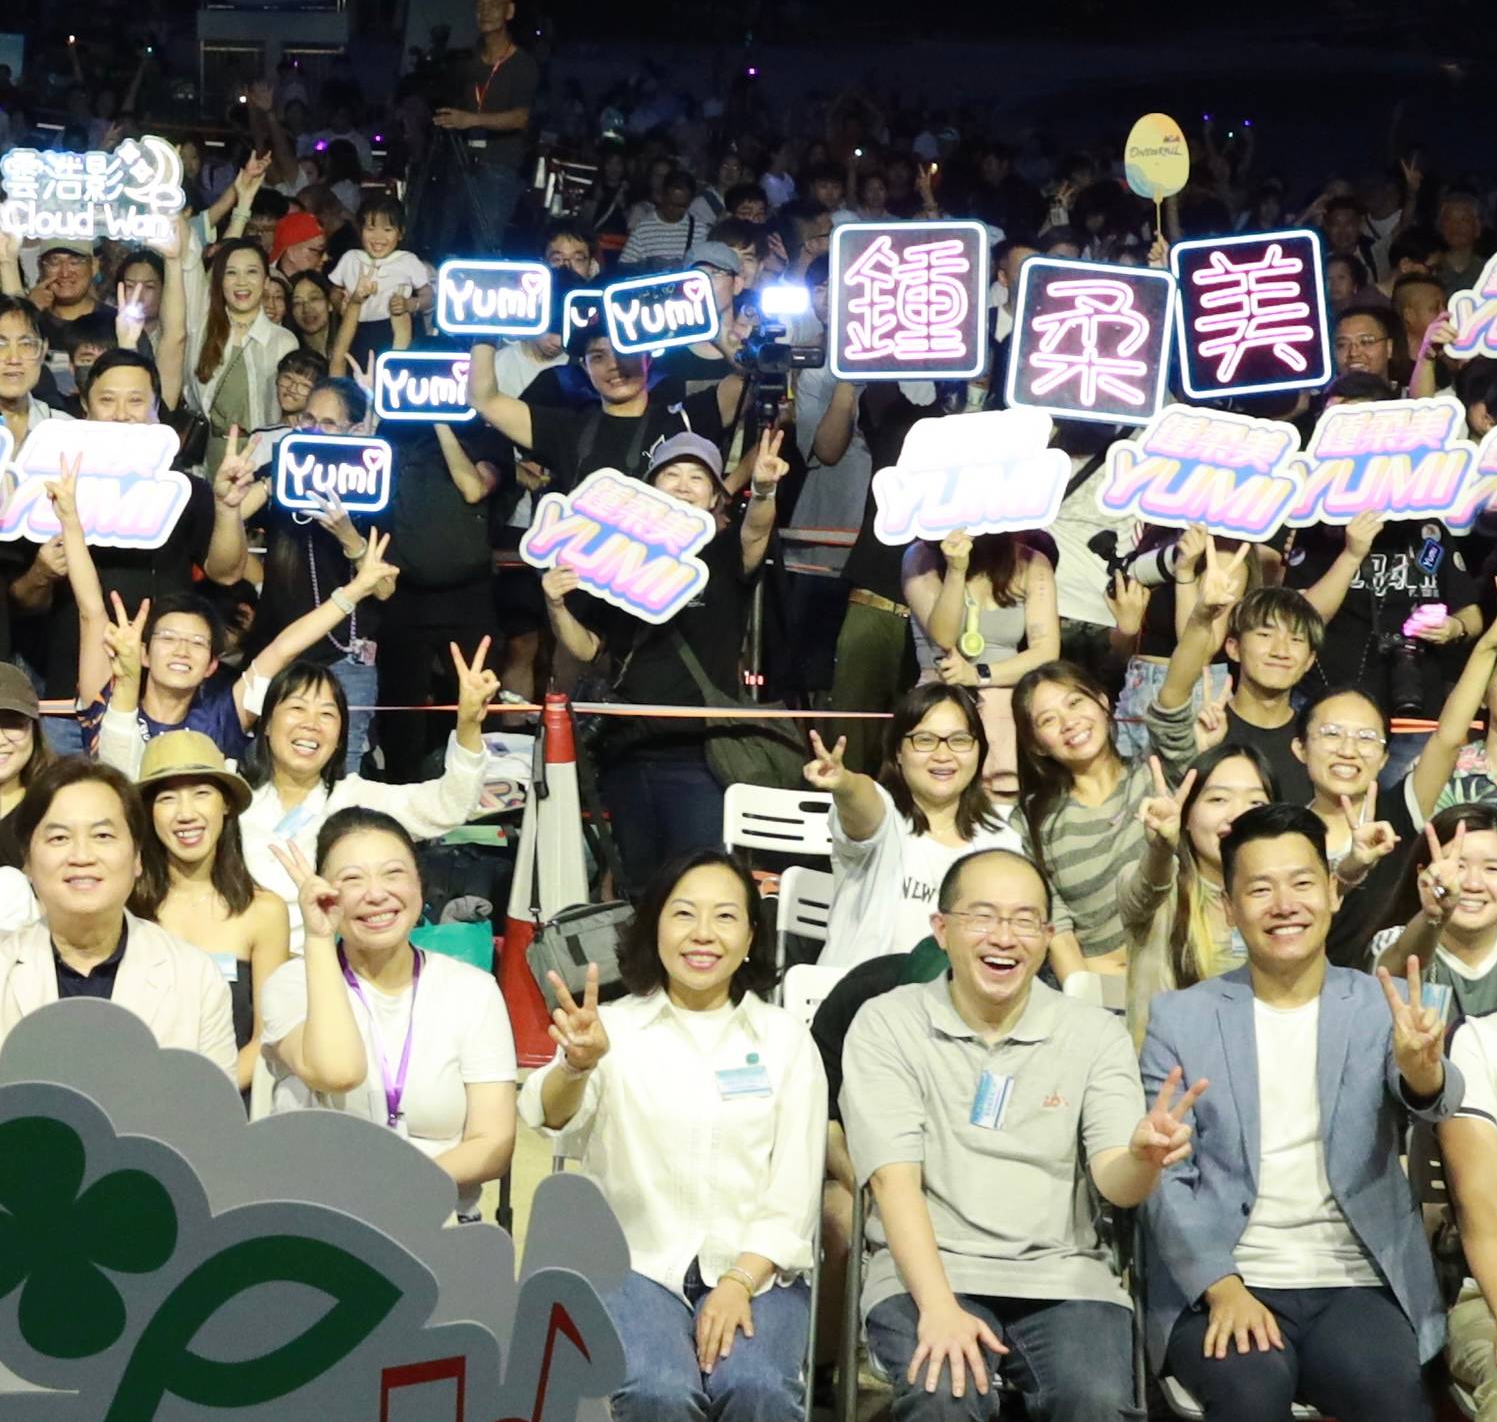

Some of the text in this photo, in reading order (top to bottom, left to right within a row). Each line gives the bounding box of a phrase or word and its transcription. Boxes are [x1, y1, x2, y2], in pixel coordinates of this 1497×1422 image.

[3, 150, 124, 203] 雲浩影
[6, 203, 94, 238] Cloud
[445, 274, 545, 322] Yumi
[611, 275, 706, 341] Yumi
[845, 235, 1315, 407] 鍾 柔 美
[381, 360, 471, 410] Yumi
[1145, 411, 1291, 473] 鍾柔美
[1314, 406, 1455, 458] 鍾柔美
[286, 448, 384, 497] Yumi
[1104, 449, 1297, 535] YUMI
[1290, 448, 1472, 518] YUMI
[526, 500, 699, 614] YUMI
